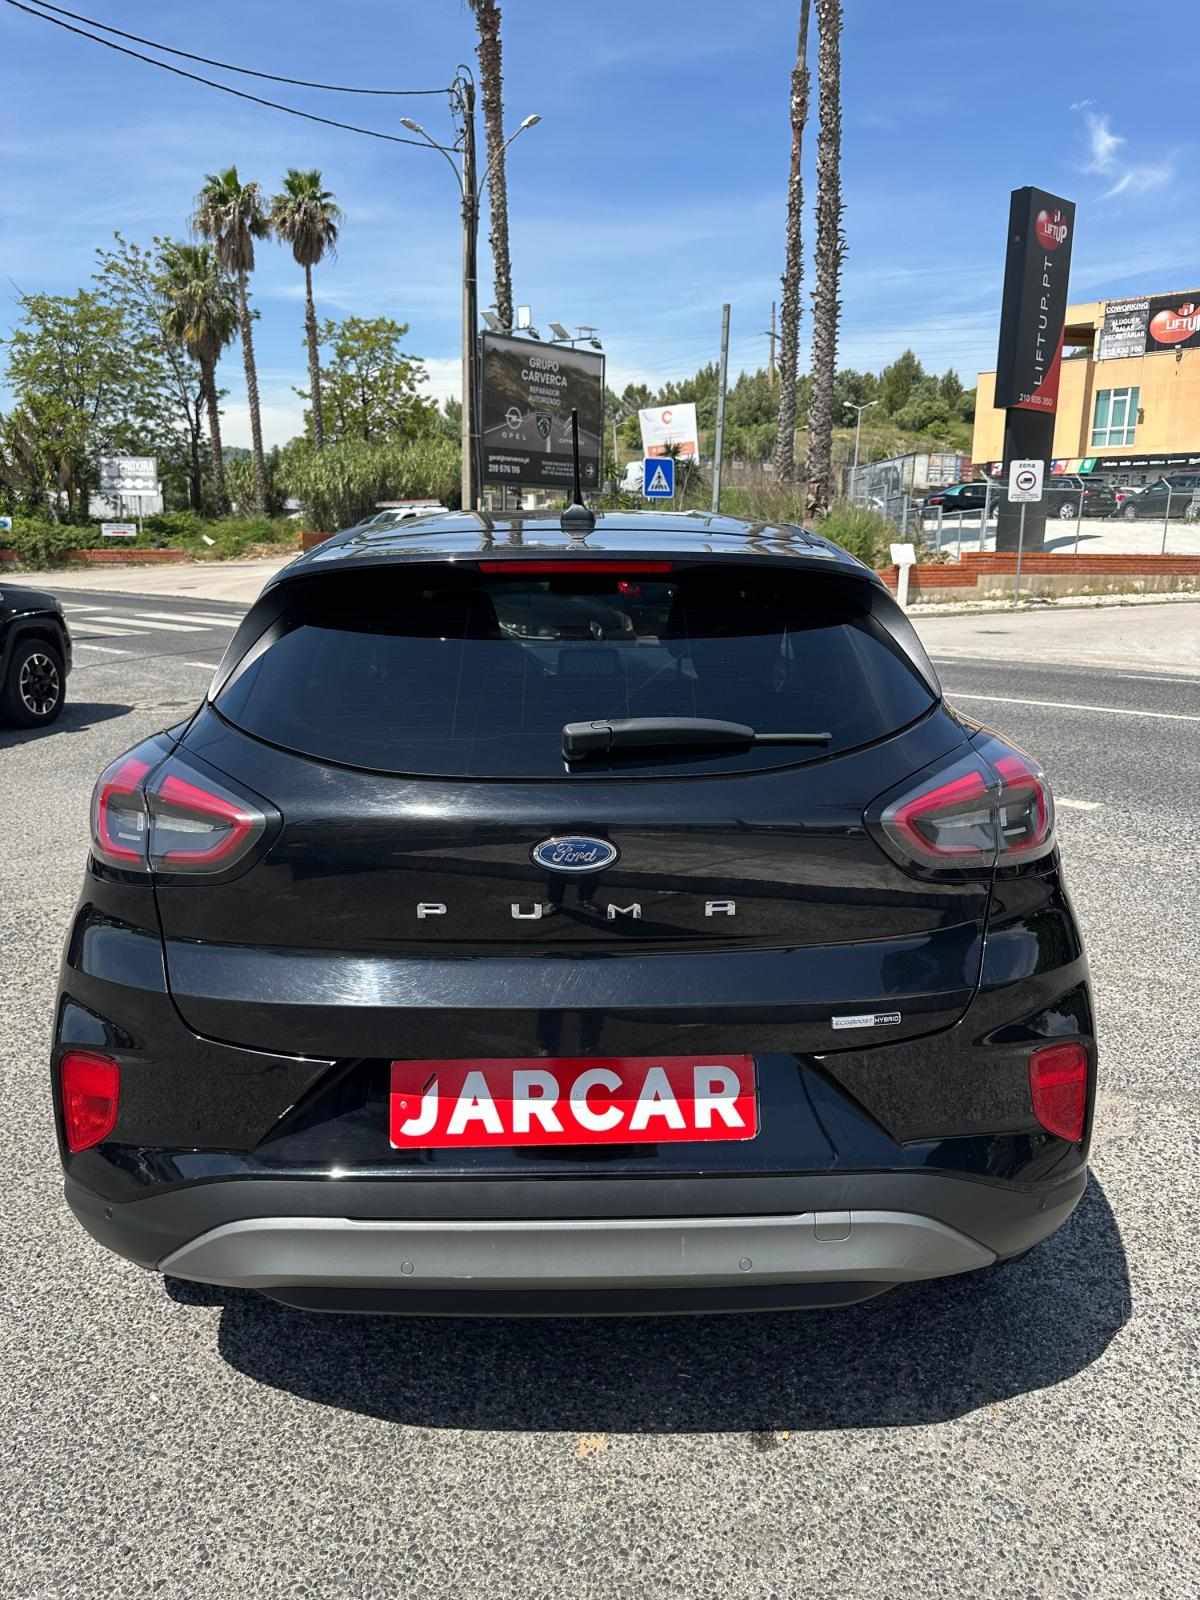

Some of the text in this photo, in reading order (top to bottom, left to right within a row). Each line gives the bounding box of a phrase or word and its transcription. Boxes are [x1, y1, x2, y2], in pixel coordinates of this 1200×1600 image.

[1106, 302, 1149, 313] COWORKING
[1033, 255, 1053, 386] LIFTUP.PT
[529, 357, 560, 372] GRUPO
[521, 369, 567, 387] CARVERCA
[552, 843, 597, 862] Ford
[416, 900, 737, 920] PUMA
[874, 1015, 899, 1024] HYBRID
[400, 1065, 746, 1137] JARCAR
